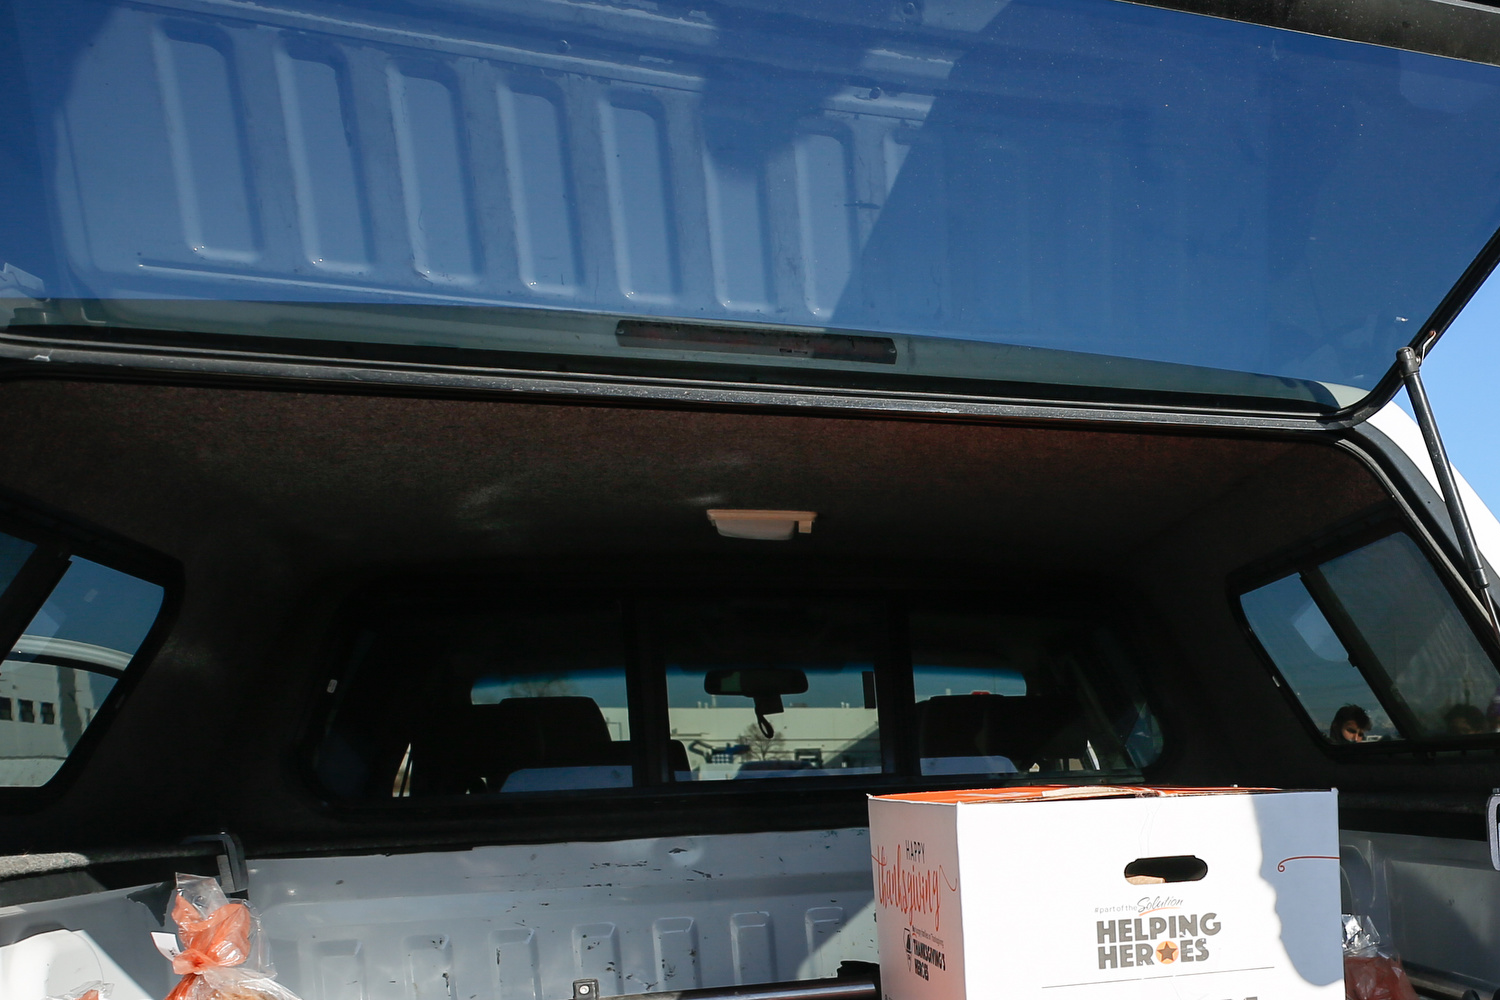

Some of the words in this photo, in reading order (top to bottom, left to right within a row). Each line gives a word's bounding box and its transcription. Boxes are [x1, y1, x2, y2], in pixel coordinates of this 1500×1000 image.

[905, 839, 926, 864] HAPPY
[1137, 896, 1184, 913] Solution
[1096, 912, 1222, 945] HELPING
[1098, 937, 1210, 970] HEROES
